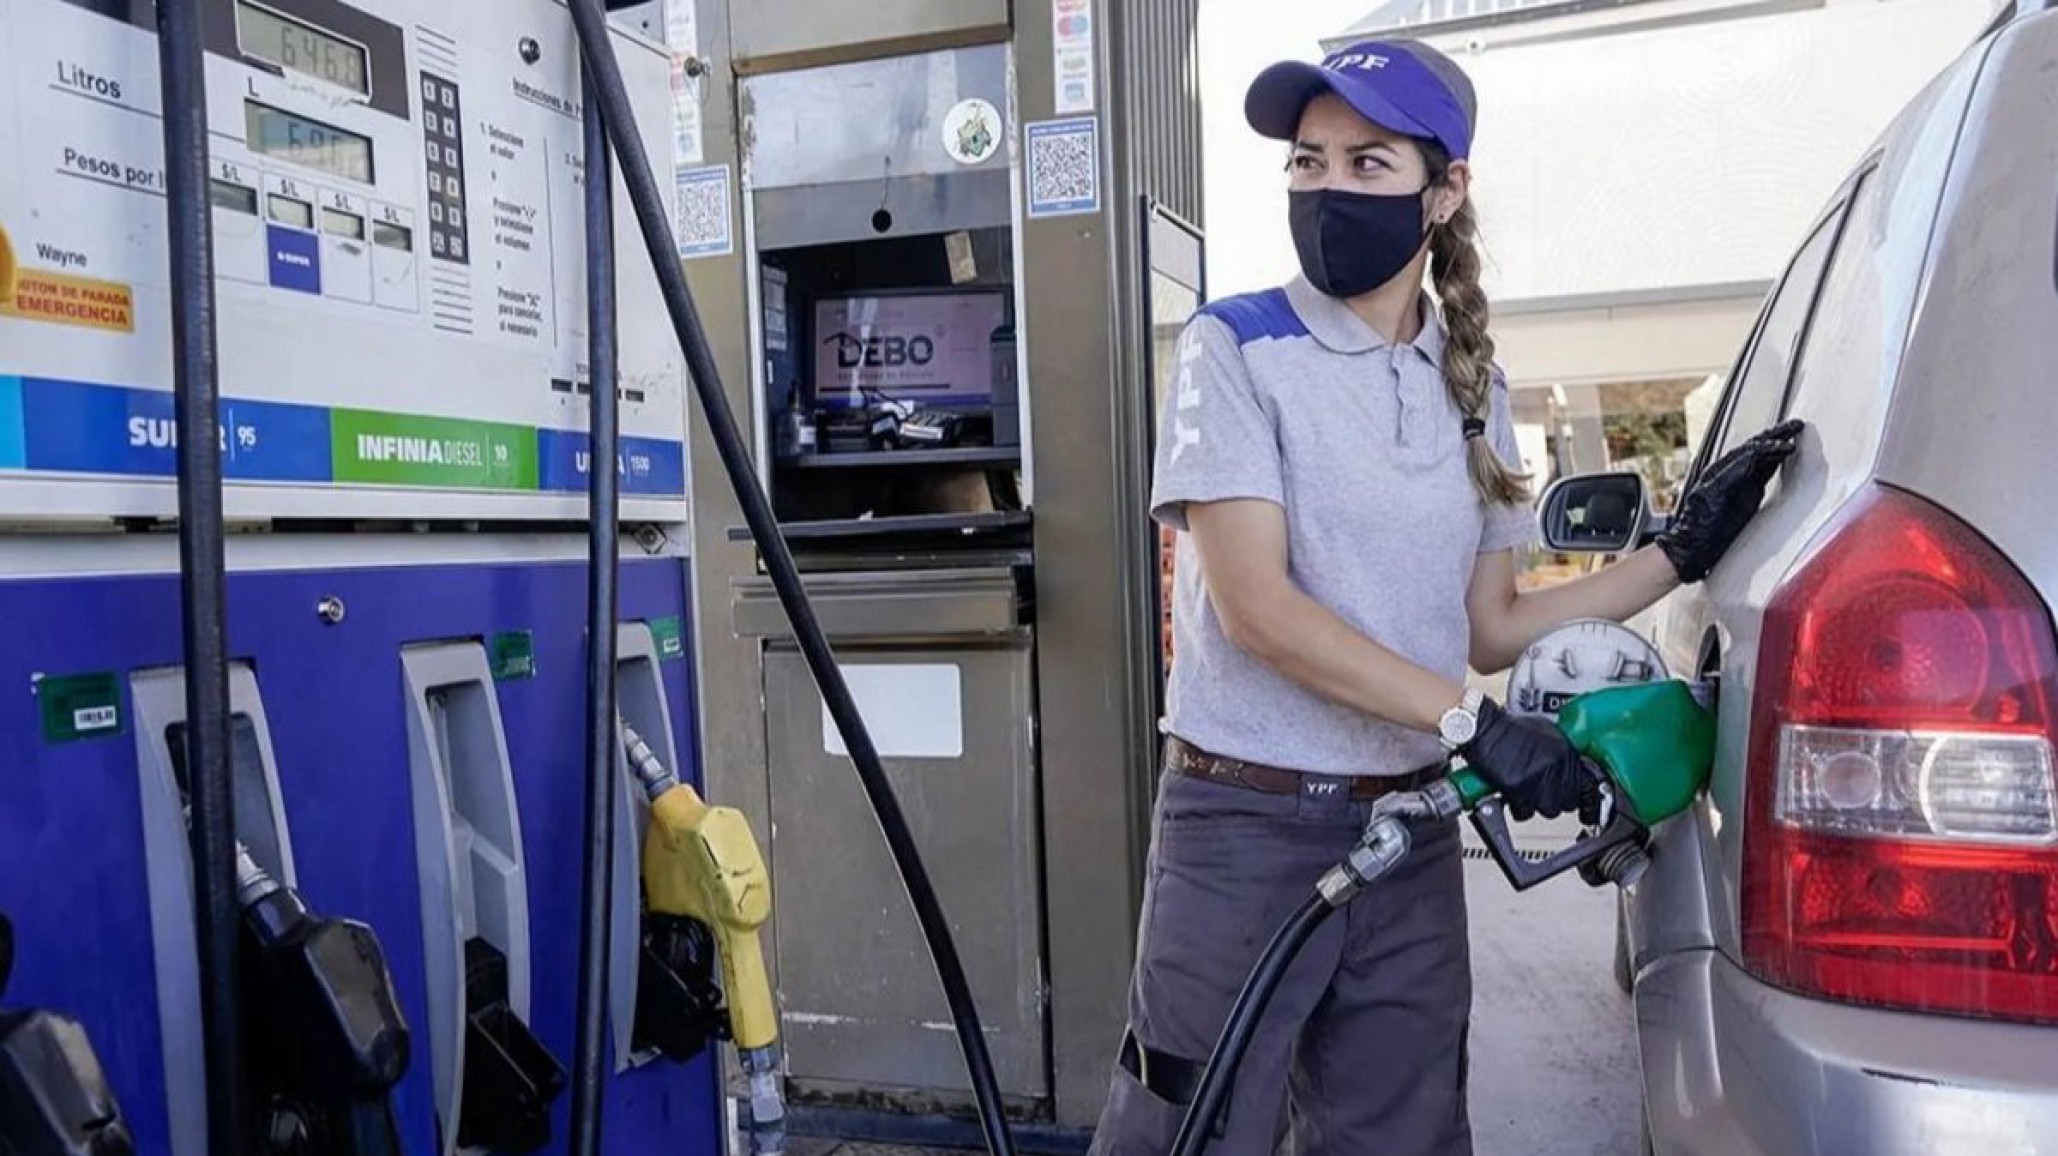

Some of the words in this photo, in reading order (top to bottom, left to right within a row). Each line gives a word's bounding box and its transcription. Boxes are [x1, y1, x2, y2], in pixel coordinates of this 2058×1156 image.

[57, 60, 121, 99] Litros
[248, 76, 259, 97] L
[64, 146, 121, 178] Pesos
[126, 167, 155, 186] por
[36, 242, 87, 266] Wayne
[16, 294, 128, 325] EMERGENCIA
[82, 289, 129, 306] PARADA
[824, 333, 934, 368] DEBO
[1171, 325, 1202, 465] YPF
[128, 416, 227, 452] SUR
[237, 426, 257, 447] 95
[357, 433, 443, 464] INFINIA
[1307, 783, 1338, 795] YPF
